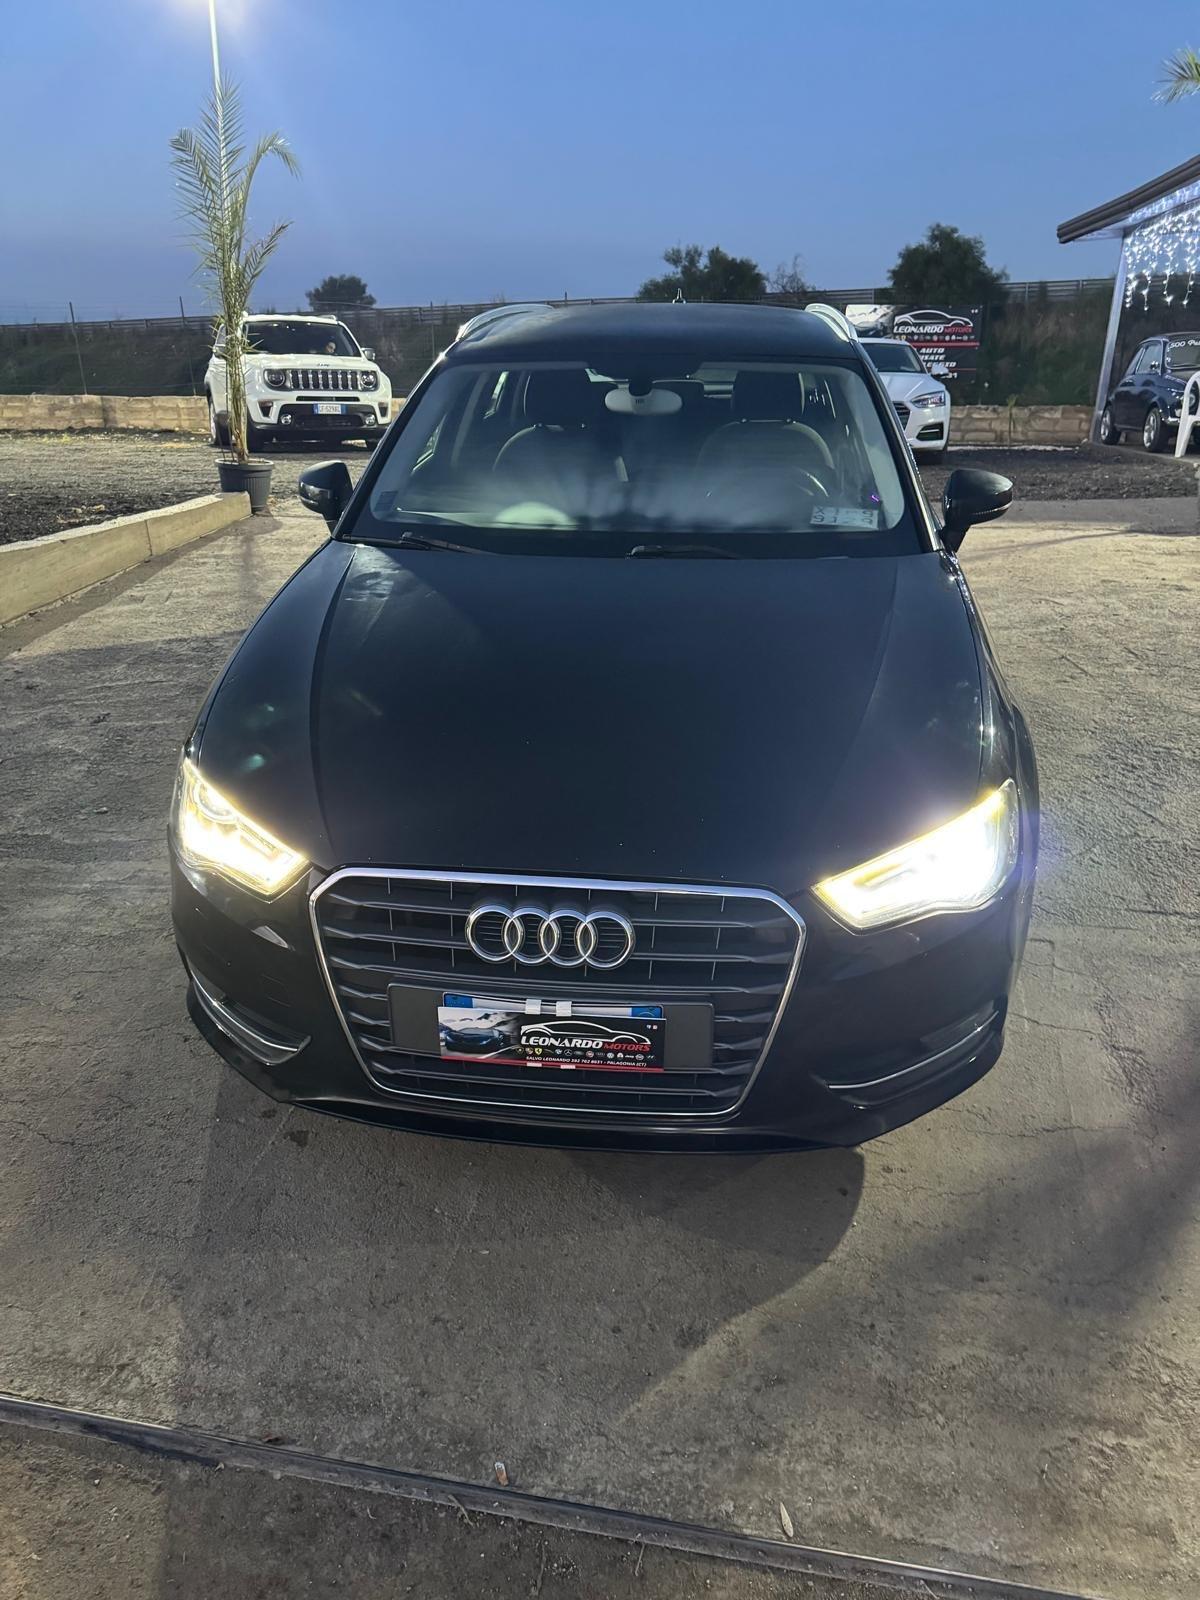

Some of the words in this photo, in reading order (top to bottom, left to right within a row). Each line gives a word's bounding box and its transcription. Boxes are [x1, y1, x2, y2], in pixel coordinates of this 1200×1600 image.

[893, 325, 944, 333] LEONARDO
[521, 1036, 602, 1049] LEONARDO
[604, 1043, 650, 1052] MOTORS
